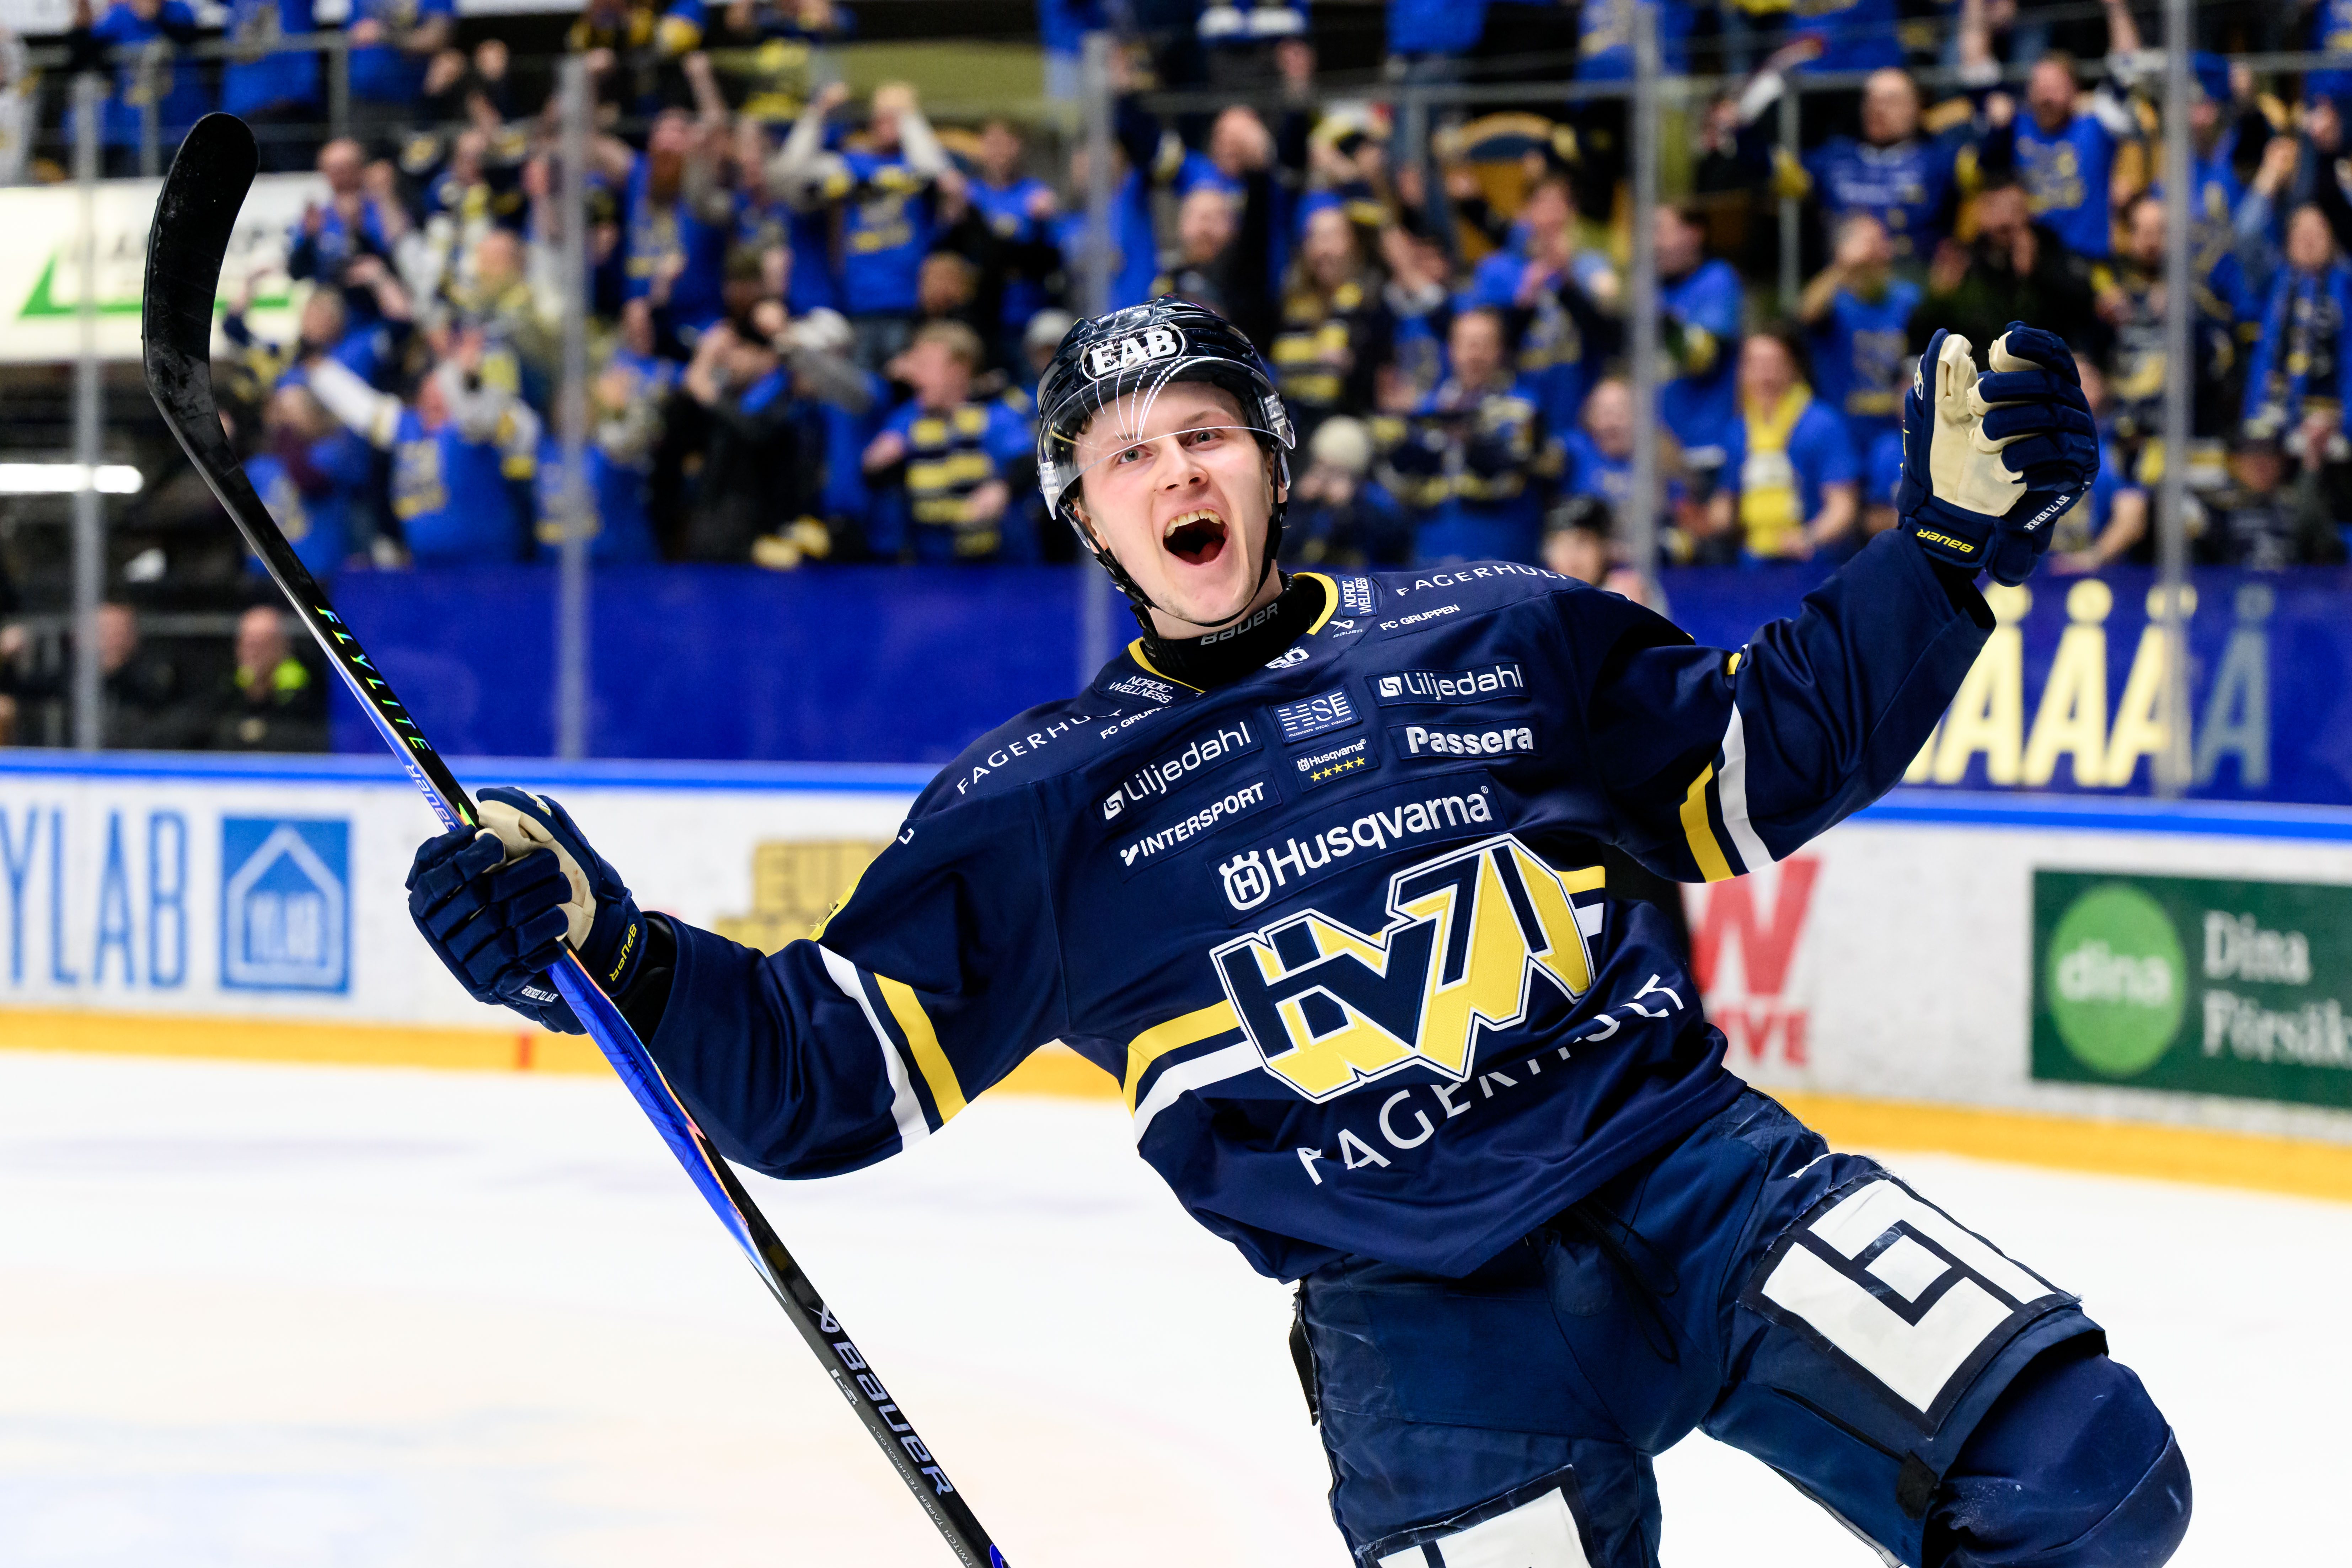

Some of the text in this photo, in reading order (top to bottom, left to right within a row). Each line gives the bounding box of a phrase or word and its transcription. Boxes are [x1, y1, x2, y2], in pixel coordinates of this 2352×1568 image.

[1089, 330, 1177, 376] EAB
[2056, 495, 2070, 507] HV
[1917, 528, 1974, 553] BAUER
[1342, 580, 1357, 607] NORDIC
[1355, 578, 1372, 614] WELLNESS
[1200, 603, 1278, 645] BAUER
[1380, 604, 1461, 631] FC GRUPPEN
[315, 605, 432, 750] FLYLITE
[1108, 682, 1173, 703] WELLNESS
[1126, 676, 1173, 693] NORDIC
[1404, 664, 1523, 701] Liljedahl
[1100, 705, 1172, 739] FC GRUP
[1288, 728, 1313, 737] HILLERSTORPS
[1331, 716, 1352, 726] EMBALLAGE
[1406, 727, 1533, 754] Passera
[957, 709, 1122, 795] FAGERHU
[1124, 721, 1251, 801] Liljedahl
[1140, 782, 1264, 856] INTERSPORT
[2204, 910, 2311, 986] Dina
[2057, 940, 2174, 1006] dina
[833, 1342, 954, 1496] BAUER
[870, 1424, 972, 1568] TWITCH TAPER TECHNOLOGY
